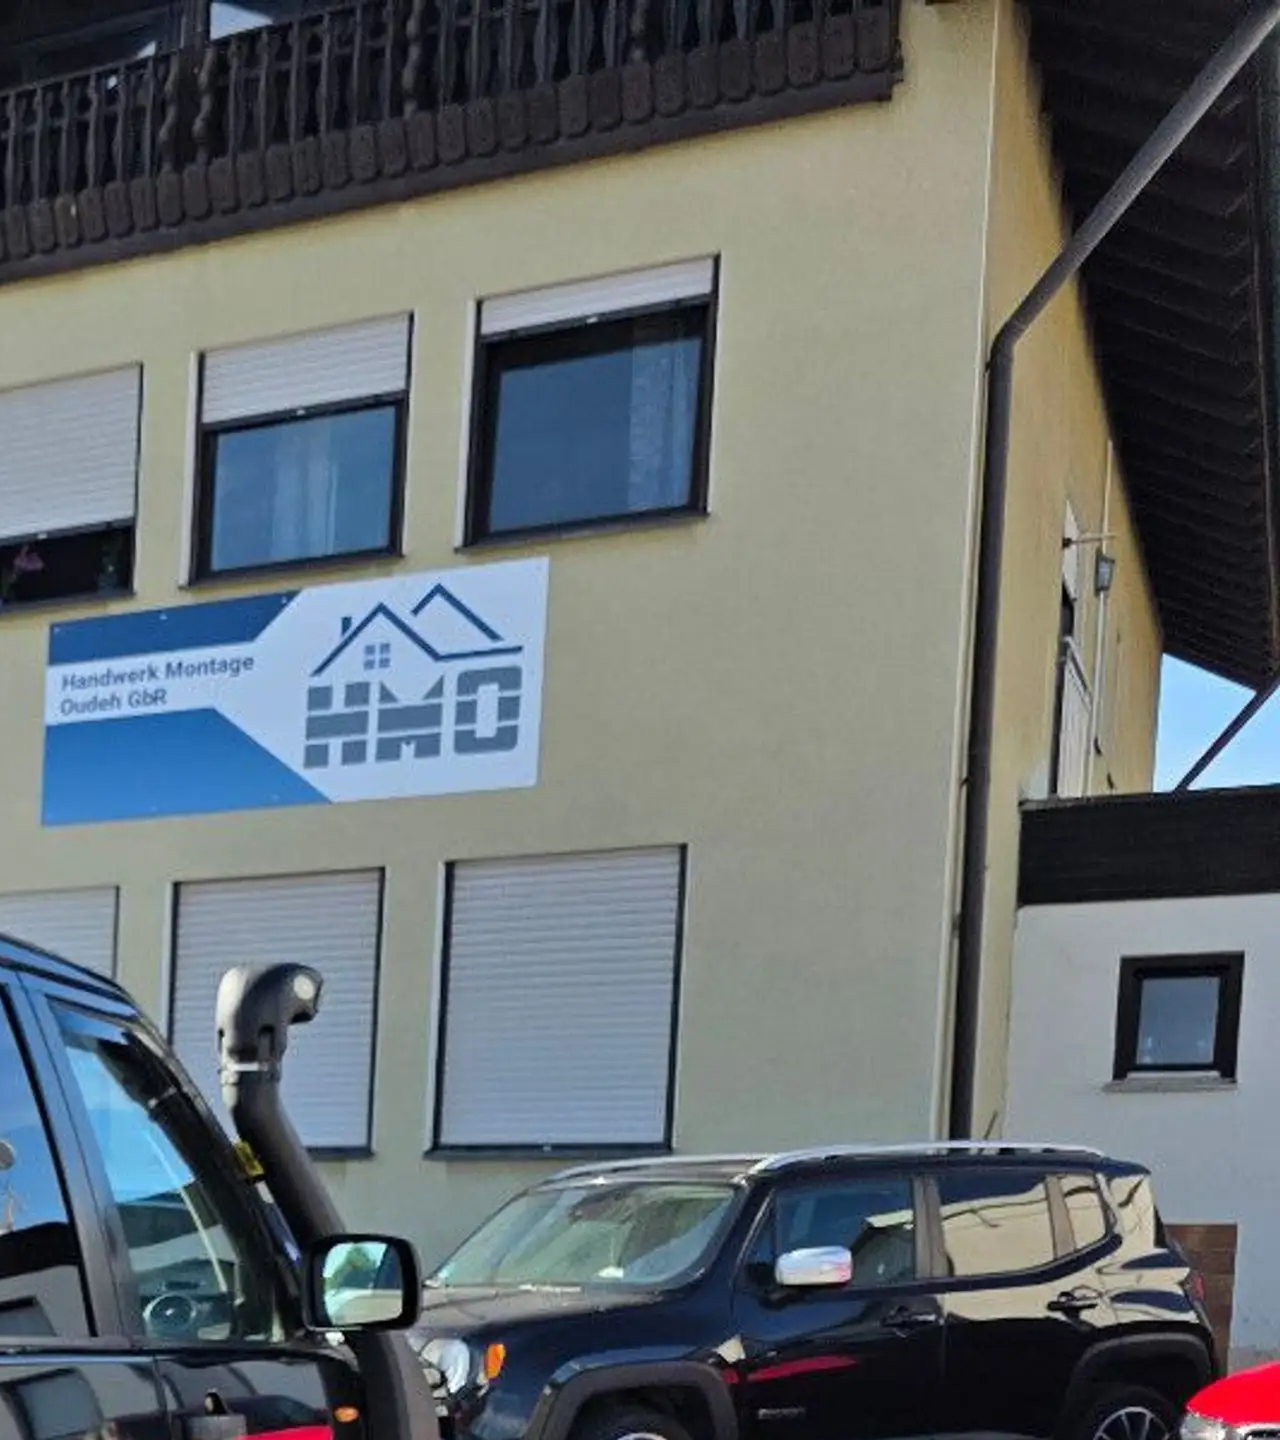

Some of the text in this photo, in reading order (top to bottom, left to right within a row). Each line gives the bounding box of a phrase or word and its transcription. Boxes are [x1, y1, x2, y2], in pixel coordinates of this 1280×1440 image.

[61, 656, 255, 691] Handwerk Montage
[128, 688, 168, 708] GbR
[303, 665, 523, 768] HMO
